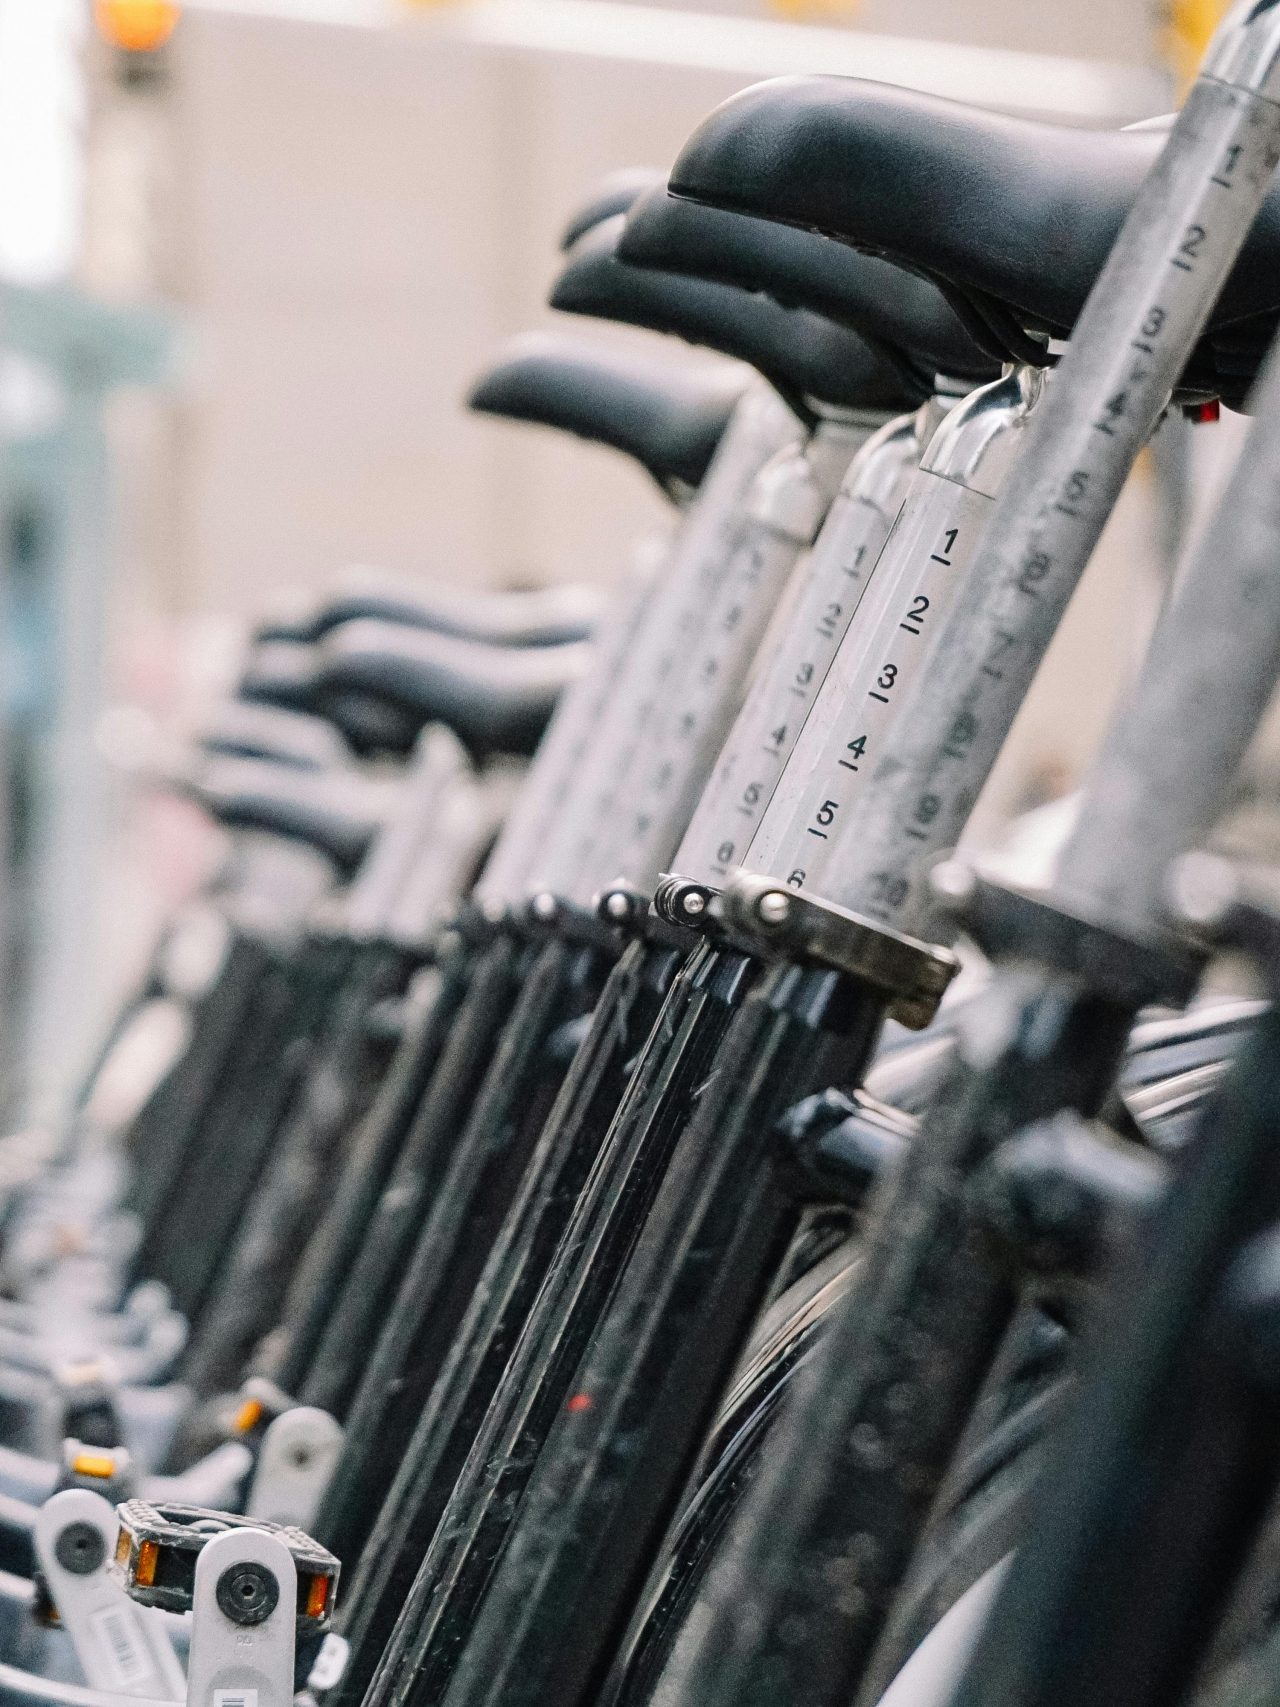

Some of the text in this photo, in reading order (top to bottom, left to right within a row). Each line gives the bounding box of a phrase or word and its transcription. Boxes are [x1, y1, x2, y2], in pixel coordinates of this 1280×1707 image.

[1226, 144, 1244, 173] 1
[1180, 224, 1206, 258] 2
[1142, 308, 1166, 338] 3
[944, 528, 959, 554] 1
[906, 595, 930, 623] 2
[877, 663, 898, 690] 3
[846, 735, 868, 760] 4
[816, 800, 839, 826] 5
